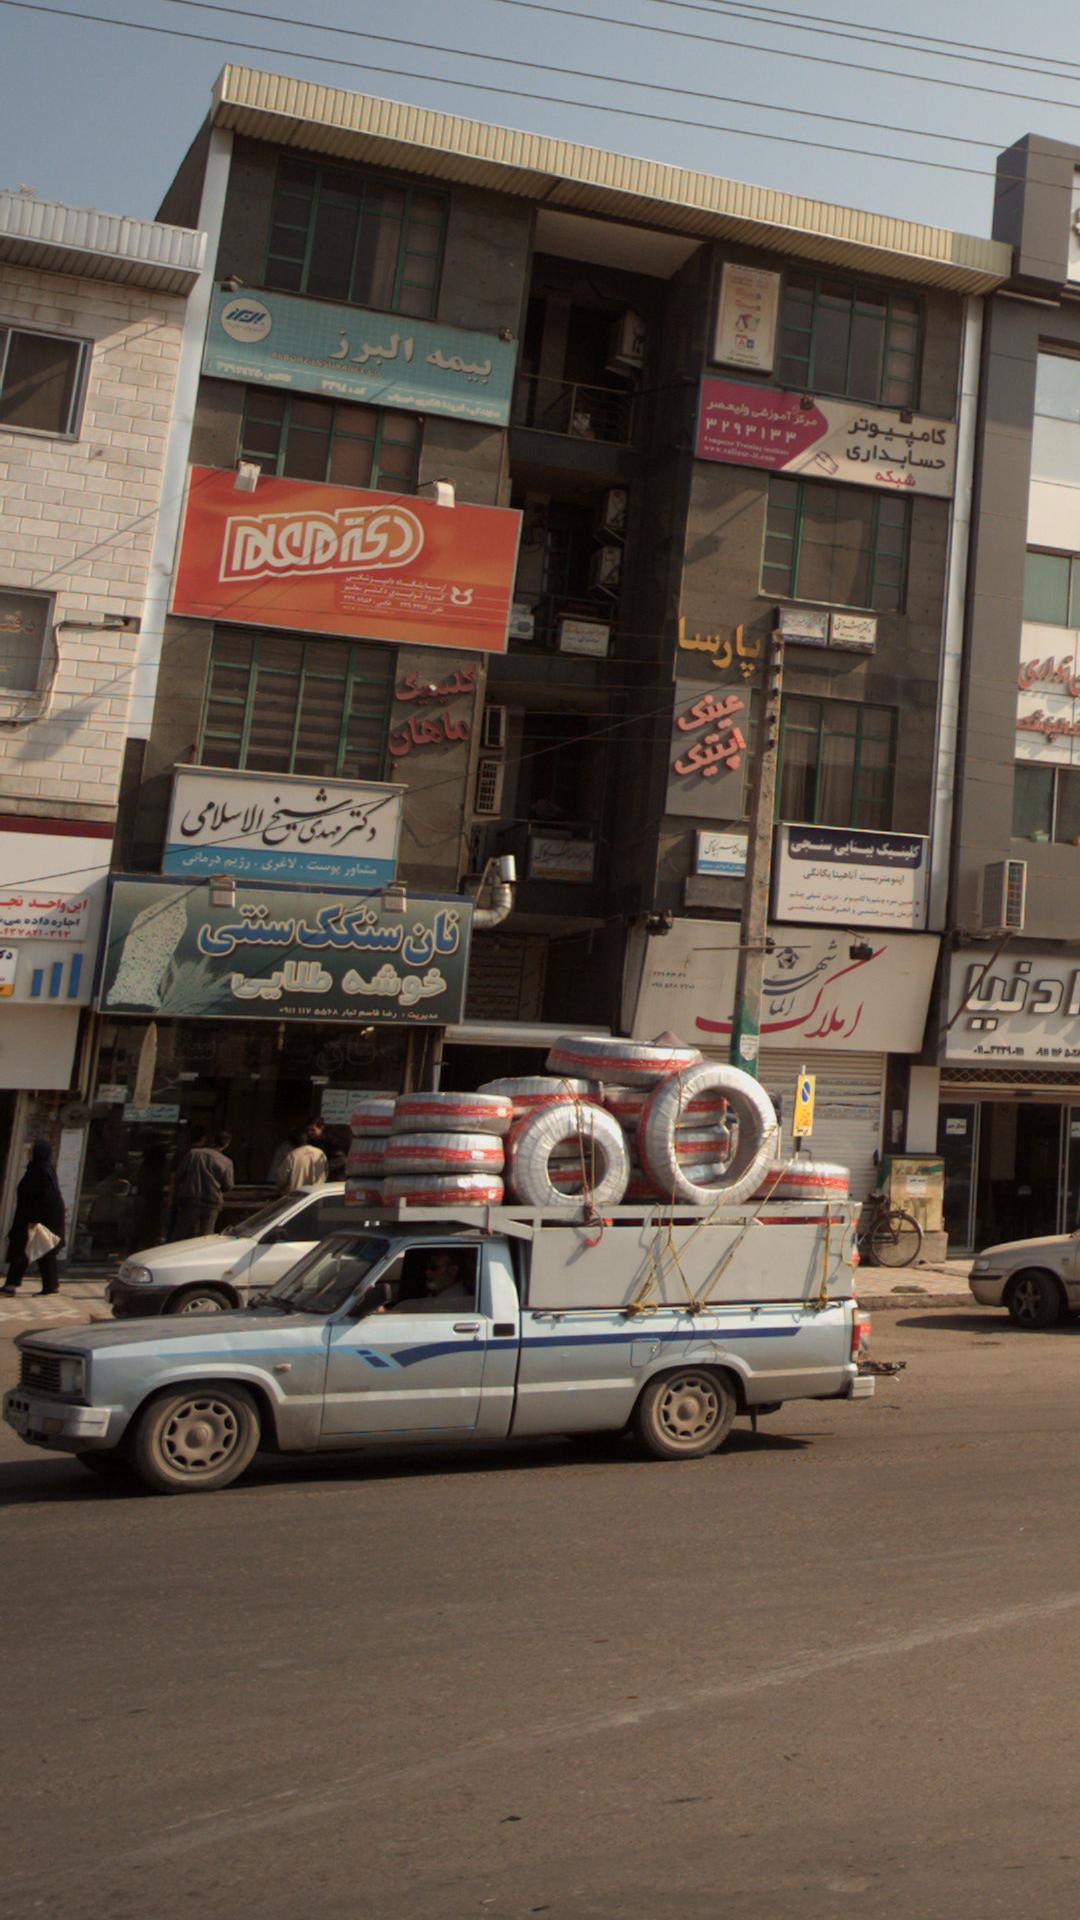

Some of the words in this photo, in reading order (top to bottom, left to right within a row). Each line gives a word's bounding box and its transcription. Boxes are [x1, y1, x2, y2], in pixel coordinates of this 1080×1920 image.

[328, 330, 414, 365] البرز
[426, 350, 492, 384] بیمه
[706, 400, 750, 416] ولیعصر
[752, 408, 791, 422] آموزشی
[793, 412, 818, 427] مرکز
[848, 416, 946, 447] کامپیوتر
[846, 445, 945, 470] حسابداری
[875, 468, 915, 489] شبکه
[678, 616, 761, 678] پارسا
[395, 664, 477, 703] کلینیک
[676, 695, 745, 731] عینک
[389, 711, 470, 756] ماهان
[674, 727, 746, 776] اپتیک
[180, 800, 265, 837] الاسلامی
[261, 787, 353, 845] شیخ
[330, 794, 396, 847] دکتر
[298, 820, 342, 843] مهدی
[790, 839, 833, 854] سنجی
[834, 840, 875, 858] بینایی
[876, 843, 920, 861] کلینیک
[182, 852, 221, 867] درمانی
[223, 855, 251, 870] رژیم
[261, 857, 298, 872] لاغری
[307, 860, 341, 875] پوست
[344, 862, 378, 877] مشاور
[28, 898, 66, 913] واحد
[67, 898, 88, 913] این
[4, 917, 22, 926] می
[24, 916, 49, 925] داده
[51, 917, 80, 928] اجاره
[198, 903, 296, 956] سنتی
[296, 903, 403, 950] سنگک
[402, 908, 461, 966] نان
[230, 960, 333, 1000] طلایی
[341, 963, 447, 1005] خوشه
[695, 944, 888, 1038] املاک
[279, 1006, 296, 1015] ۰۹۱۱
[358, 1008, 381, 1018] قاسم
[382, 1008, 398, 1019] رضا
[407, 1009, 438, 1020] مدیریت
